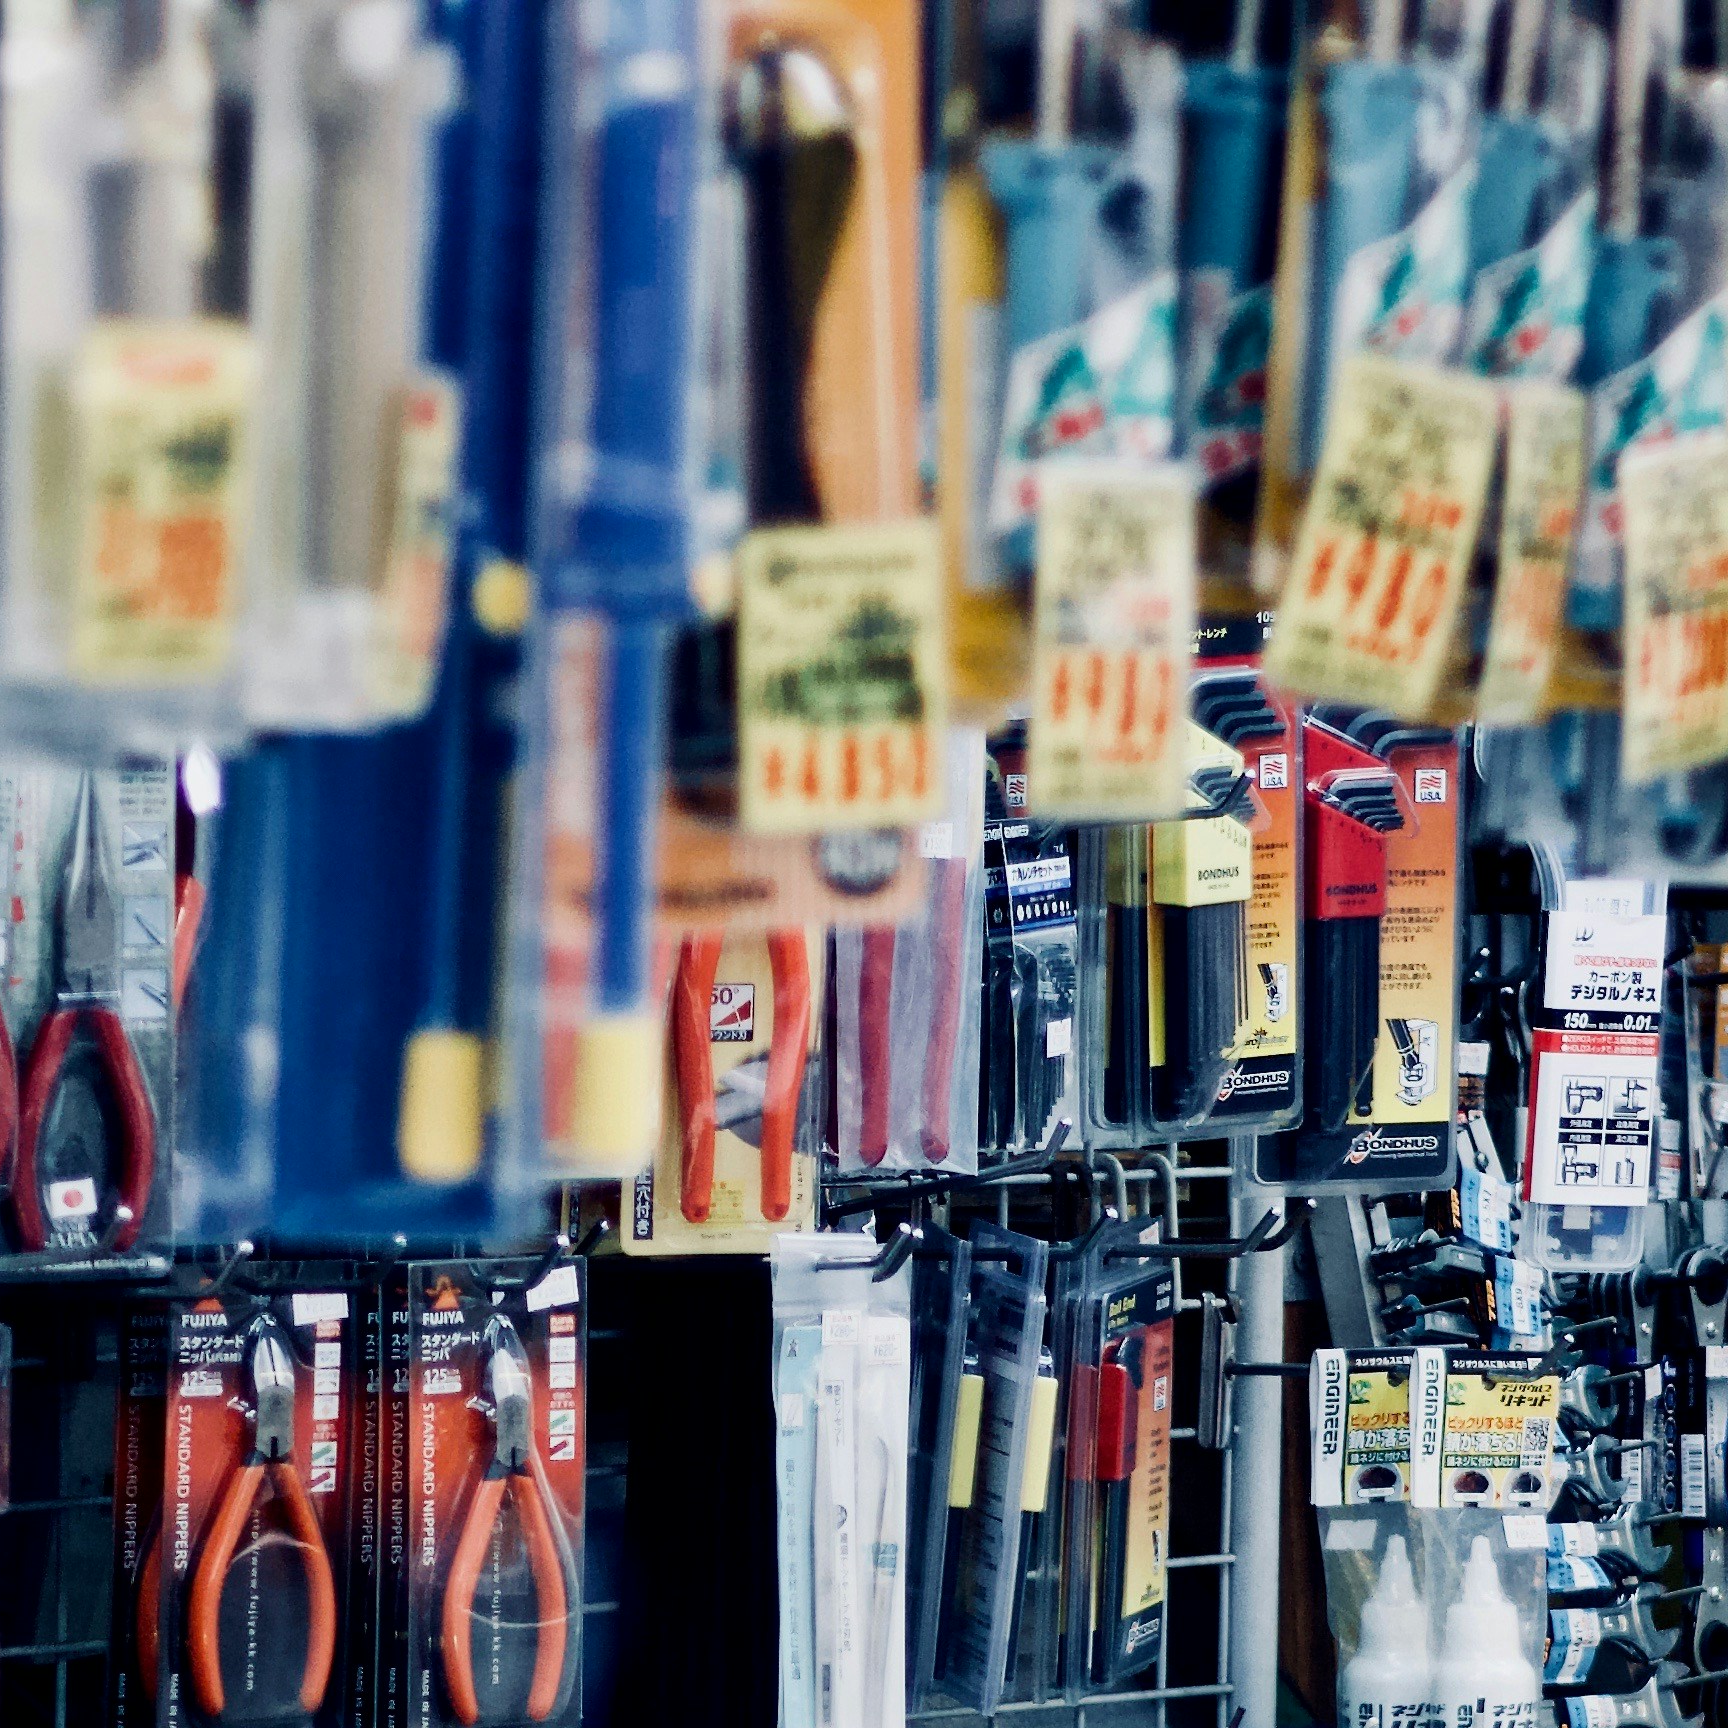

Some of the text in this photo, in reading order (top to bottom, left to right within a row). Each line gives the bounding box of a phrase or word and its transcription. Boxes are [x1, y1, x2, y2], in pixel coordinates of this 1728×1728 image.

[1198, 867, 1239, 881] BONDHUS
[1589, 970, 1642, 984] カーボン製
[1571, 985, 1656, 1002] デジタルノギス
[1351, 1137, 1437, 1154] BONDHUS
[182, 1313, 228, 1328] FUJIYA
[422, 1311, 465, 1325] FUJIYA
[179, 1335, 244, 1350] スタンダード
[421, 1332, 480, 1348] スタンダード
[422, 1349, 450, 1362] ニッパ
[1323, 1358, 1341, 1456] ENGINEER
[1421, 1358, 1439, 1457] ENGINEER
[1499, 1394, 1551, 1407] リキッド
[123, 1405, 140, 1570] STANDARD NIPPERS
[173, 1404, 193, 1571] STANDARD NIPPERS
[360, 1401, 377, 1564] STANDARD NIPPERS
[390, 1401, 404, 1565] STANDARD NIPPERS
[421, 1402, 436, 1566] STANDARD NIPPERS
